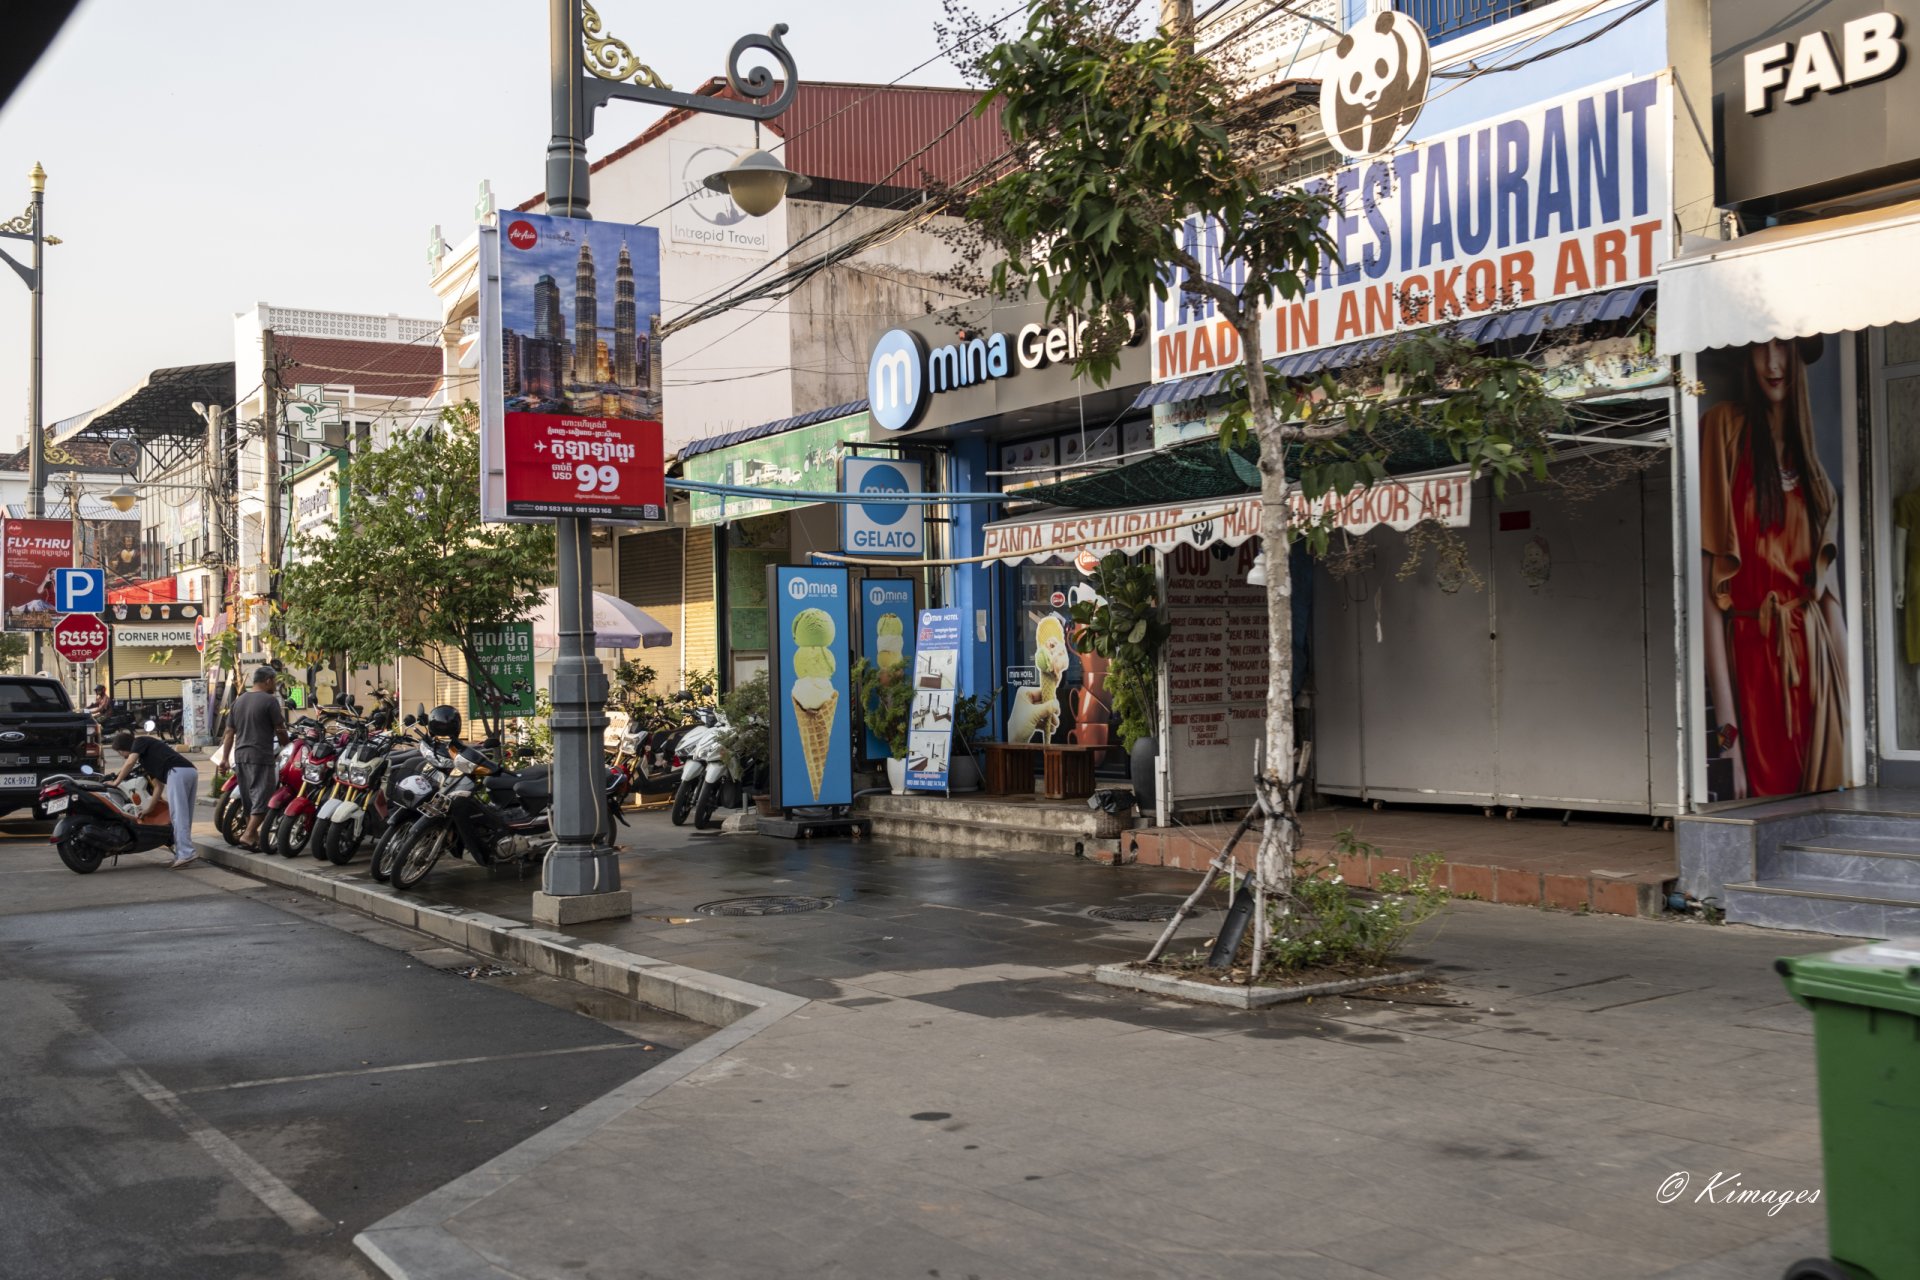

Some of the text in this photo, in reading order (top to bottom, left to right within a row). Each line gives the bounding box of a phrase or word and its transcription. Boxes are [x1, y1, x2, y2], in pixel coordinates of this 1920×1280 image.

[1744, 12, 1901, 114] FAB
[1304, 79, 1657, 295] RESTAURANT
[674, 224, 765, 246] Intrepid Travel
[1158, 219, 1663, 379] MAD IN ANGKOR ART
[928, 329, 1009, 394] mina
[552, 463, 620, 493] USD 99
[1223, 499, 1264, 538] MAD
[1321, 483, 1410, 528] ANGKOR
[1419, 476, 1469, 520] ART
[854, 530, 916, 548] GELATO
[985, 508, 1183, 556] PANDA RESTAURANT
[7, 537, 71, 549] FLY-THRU
[66, 571, 94, 609] P
[808, 582, 838, 594] mina
[885, 591, 908, 601] mina
[943, 613, 959, 621] HOTEL
[117, 631, 191, 642] CORNER HOME
[506, 652, 530, 663] Rental
[1188, 648, 1201, 657] LIFE
[1204, 647, 1222, 657] FOOD
[1188, 662, 1202, 673] LIFE
[3, 776, 36, 786] 2CK-9972
